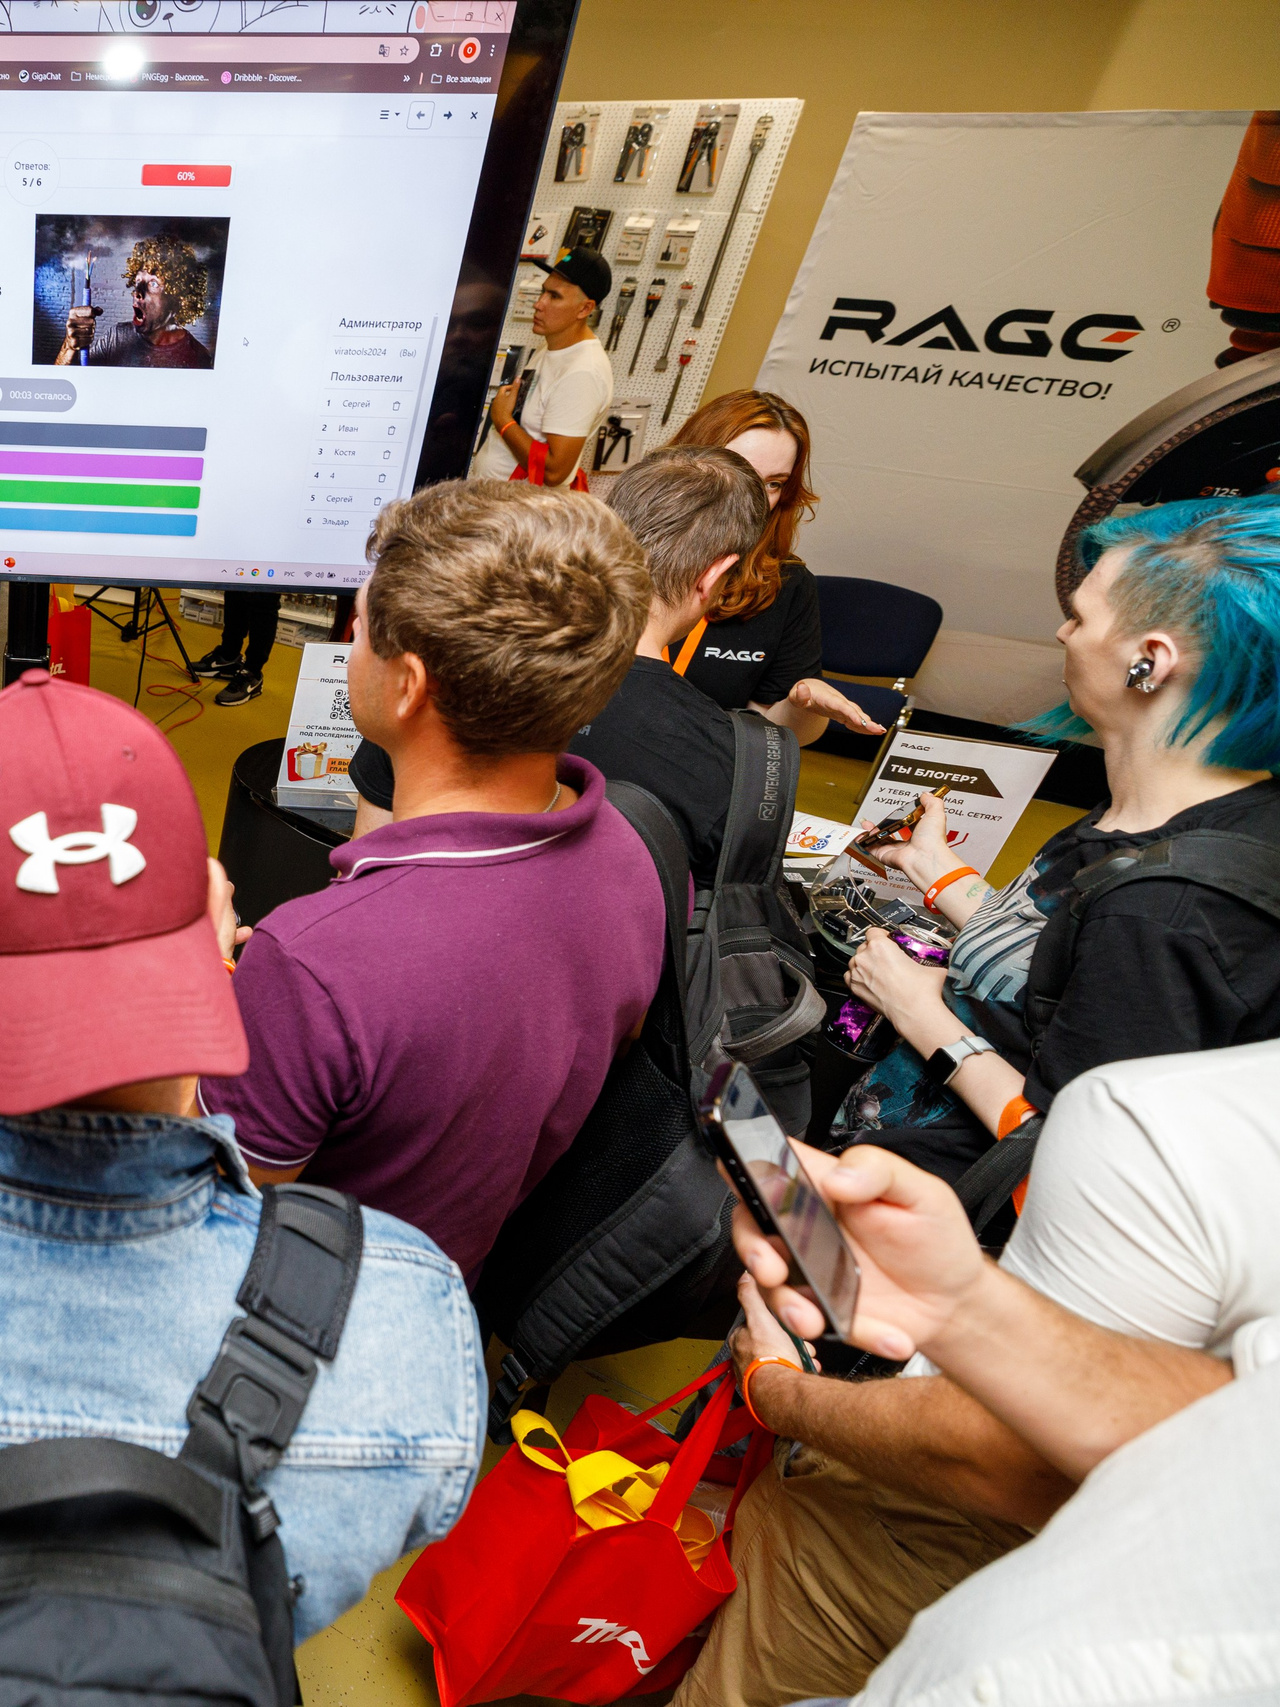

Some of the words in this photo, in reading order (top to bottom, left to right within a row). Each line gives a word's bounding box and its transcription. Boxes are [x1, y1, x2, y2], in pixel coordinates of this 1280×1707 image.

[32, 71, 62, 82] GigaChat
[141, 73, 169, 83] PNGEgg
[234, 72, 263, 82] Dribbble
[445, 74, 458, 84] Все
[459, 74, 492, 85] закладки
[13, 161, 51, 172] Ответов:
[176, 171, 195, 181] 60%
[338, 317, 423, 331] Администратор
[334, 347, 387, 357] viratools2024
[399, 349, 417, 358] (Вы)
[330, 371, 403, 384] Пользователи
[808, 357, 943, 386] ИСПЫТАЙ
[949, 370, 1113, 400] КАЧЕСТВО!
[9, 391, 32, 401] 00:03
[33, 392, 73, 402] осталось
[342, 399, 371, 409] Сергей
[338, 425, 359, 433] Иван
[334, 449, 356, 457] Костя
[326, 495, 353, 504] Сергей
[322, 518, 349, 527] Эльдар
[320, 677, 349, 685] ПОДПИШ
[767, 741, 781, 760] GEAR
[890, 764, 913, 775] ТЫ
[914, 768, 978, 784] БЛОГЕР?
[887, 788, 912, 797] ТЕБЯ
[966, 811, 1003, 823] СЕТЯХ?
[889, 882, 906, 891] ТЕБЕ
